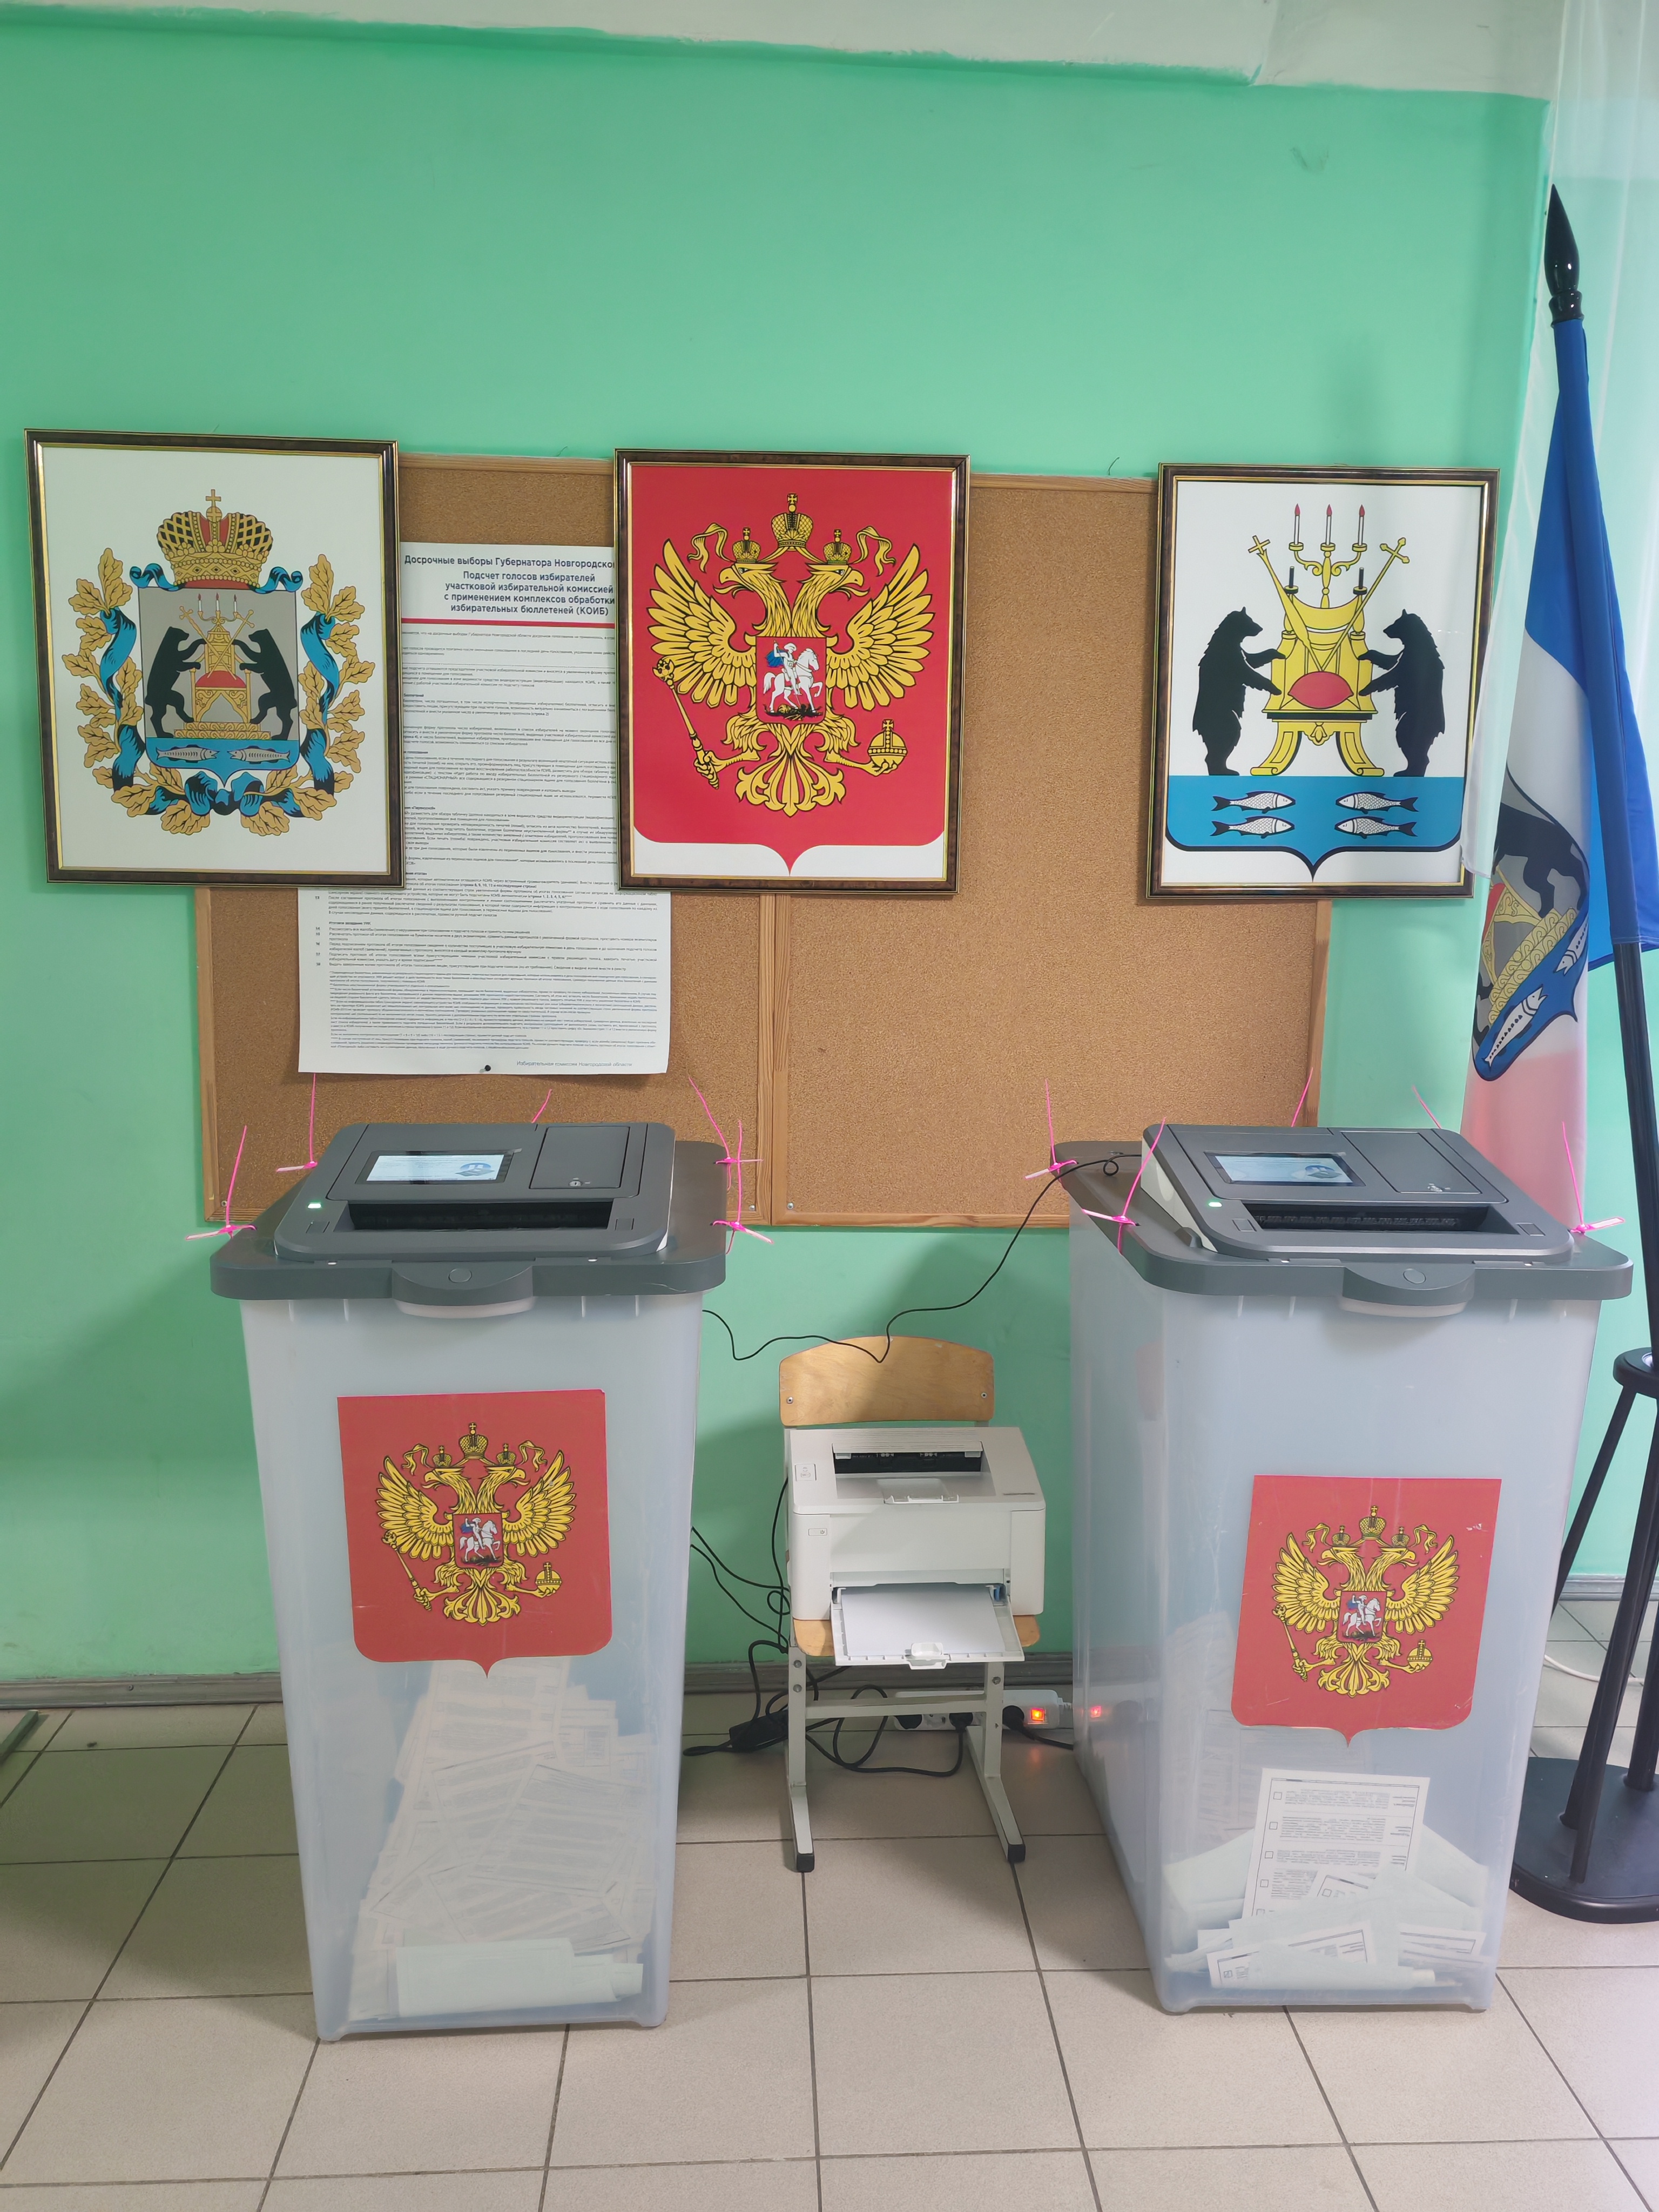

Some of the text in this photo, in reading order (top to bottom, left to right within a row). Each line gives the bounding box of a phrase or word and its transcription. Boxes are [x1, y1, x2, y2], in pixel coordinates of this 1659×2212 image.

[404, 555, 615, 569] Досрочные выборы Губернатора Новгородско
[463, 571, 500, 580] Подсчет
[539, 573, 595, 582] избирателей
[446, 582, 613, 594] участковой избирательной комиссией
[569, 596, 615, 605] обработки
[451, 604, 609, 616] избирательных бюллетеней (КОИБ)
